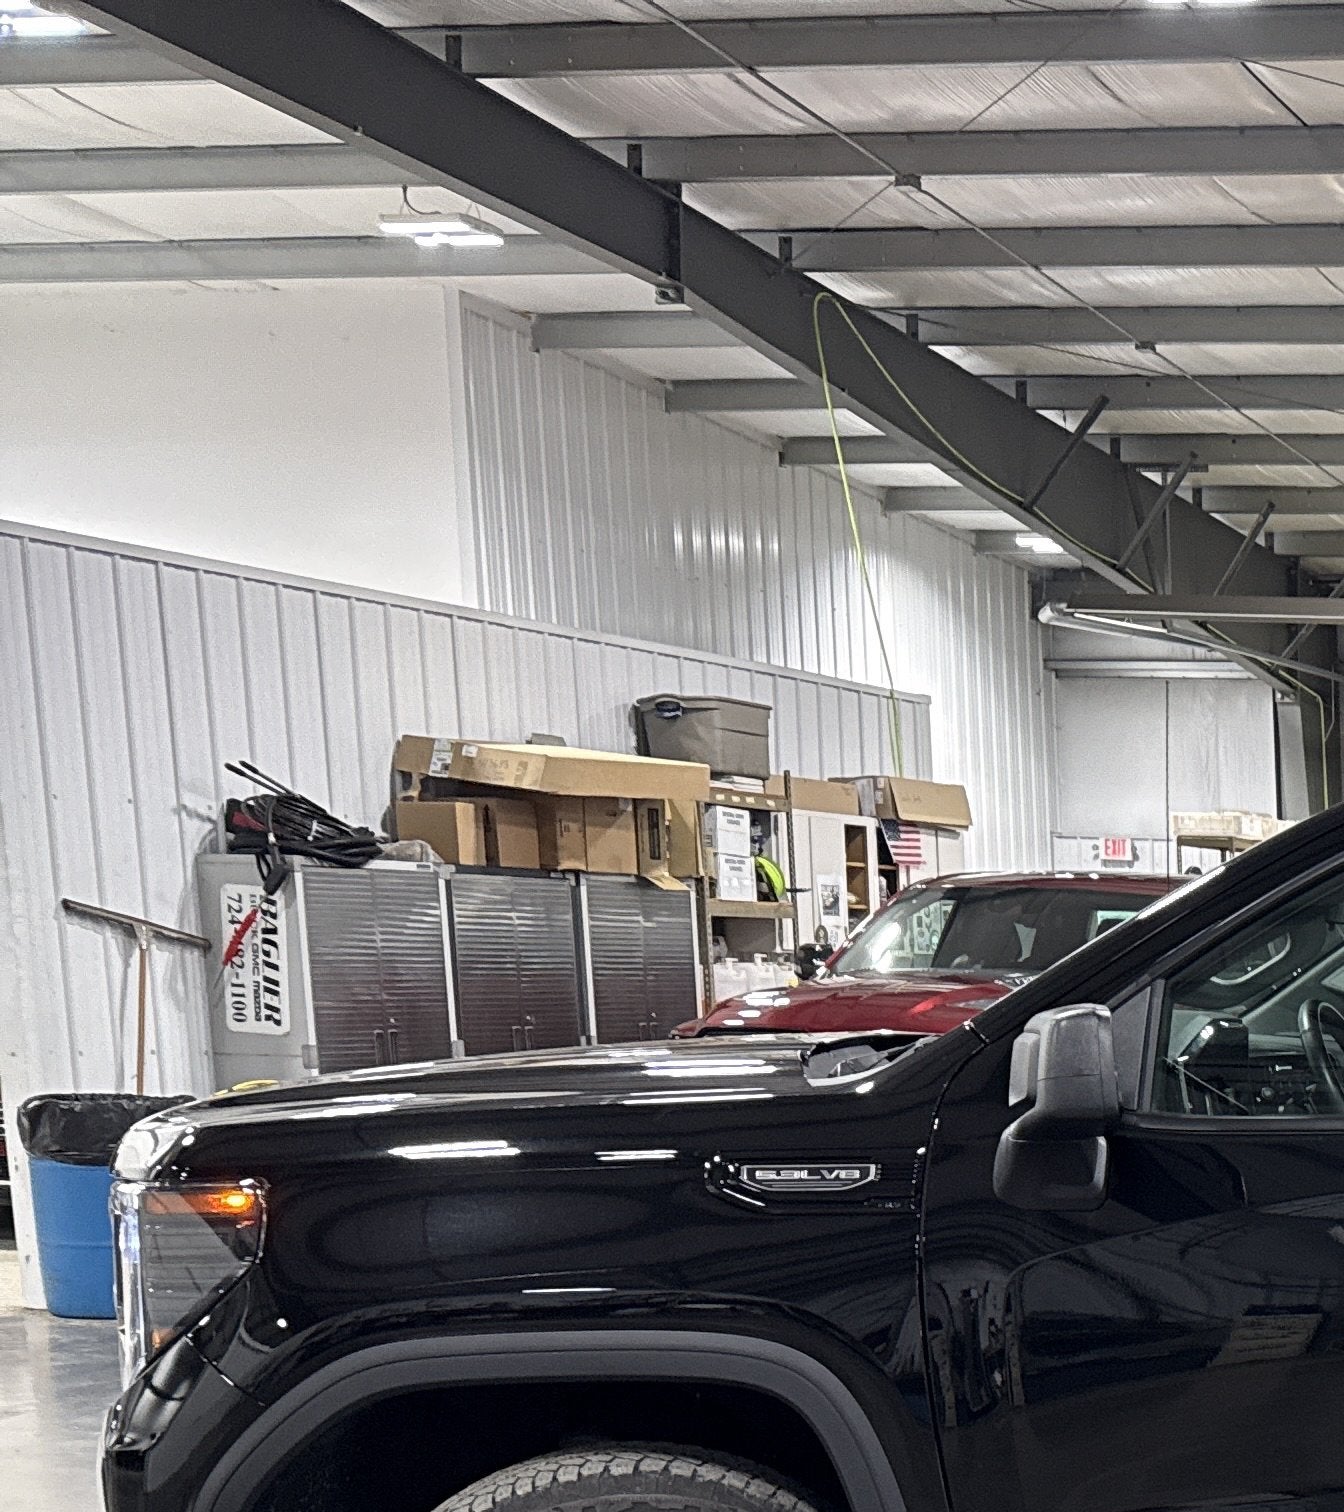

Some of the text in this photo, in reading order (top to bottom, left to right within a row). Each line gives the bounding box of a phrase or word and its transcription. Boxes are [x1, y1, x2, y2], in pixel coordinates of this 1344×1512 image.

[1104, 838, 1127, 857] EXIT
[226, 892, 248, 1023] 724-82-1100
[251, 943, 260, 977] GMC
[259, 894, 282, 1027] BAGLIER
